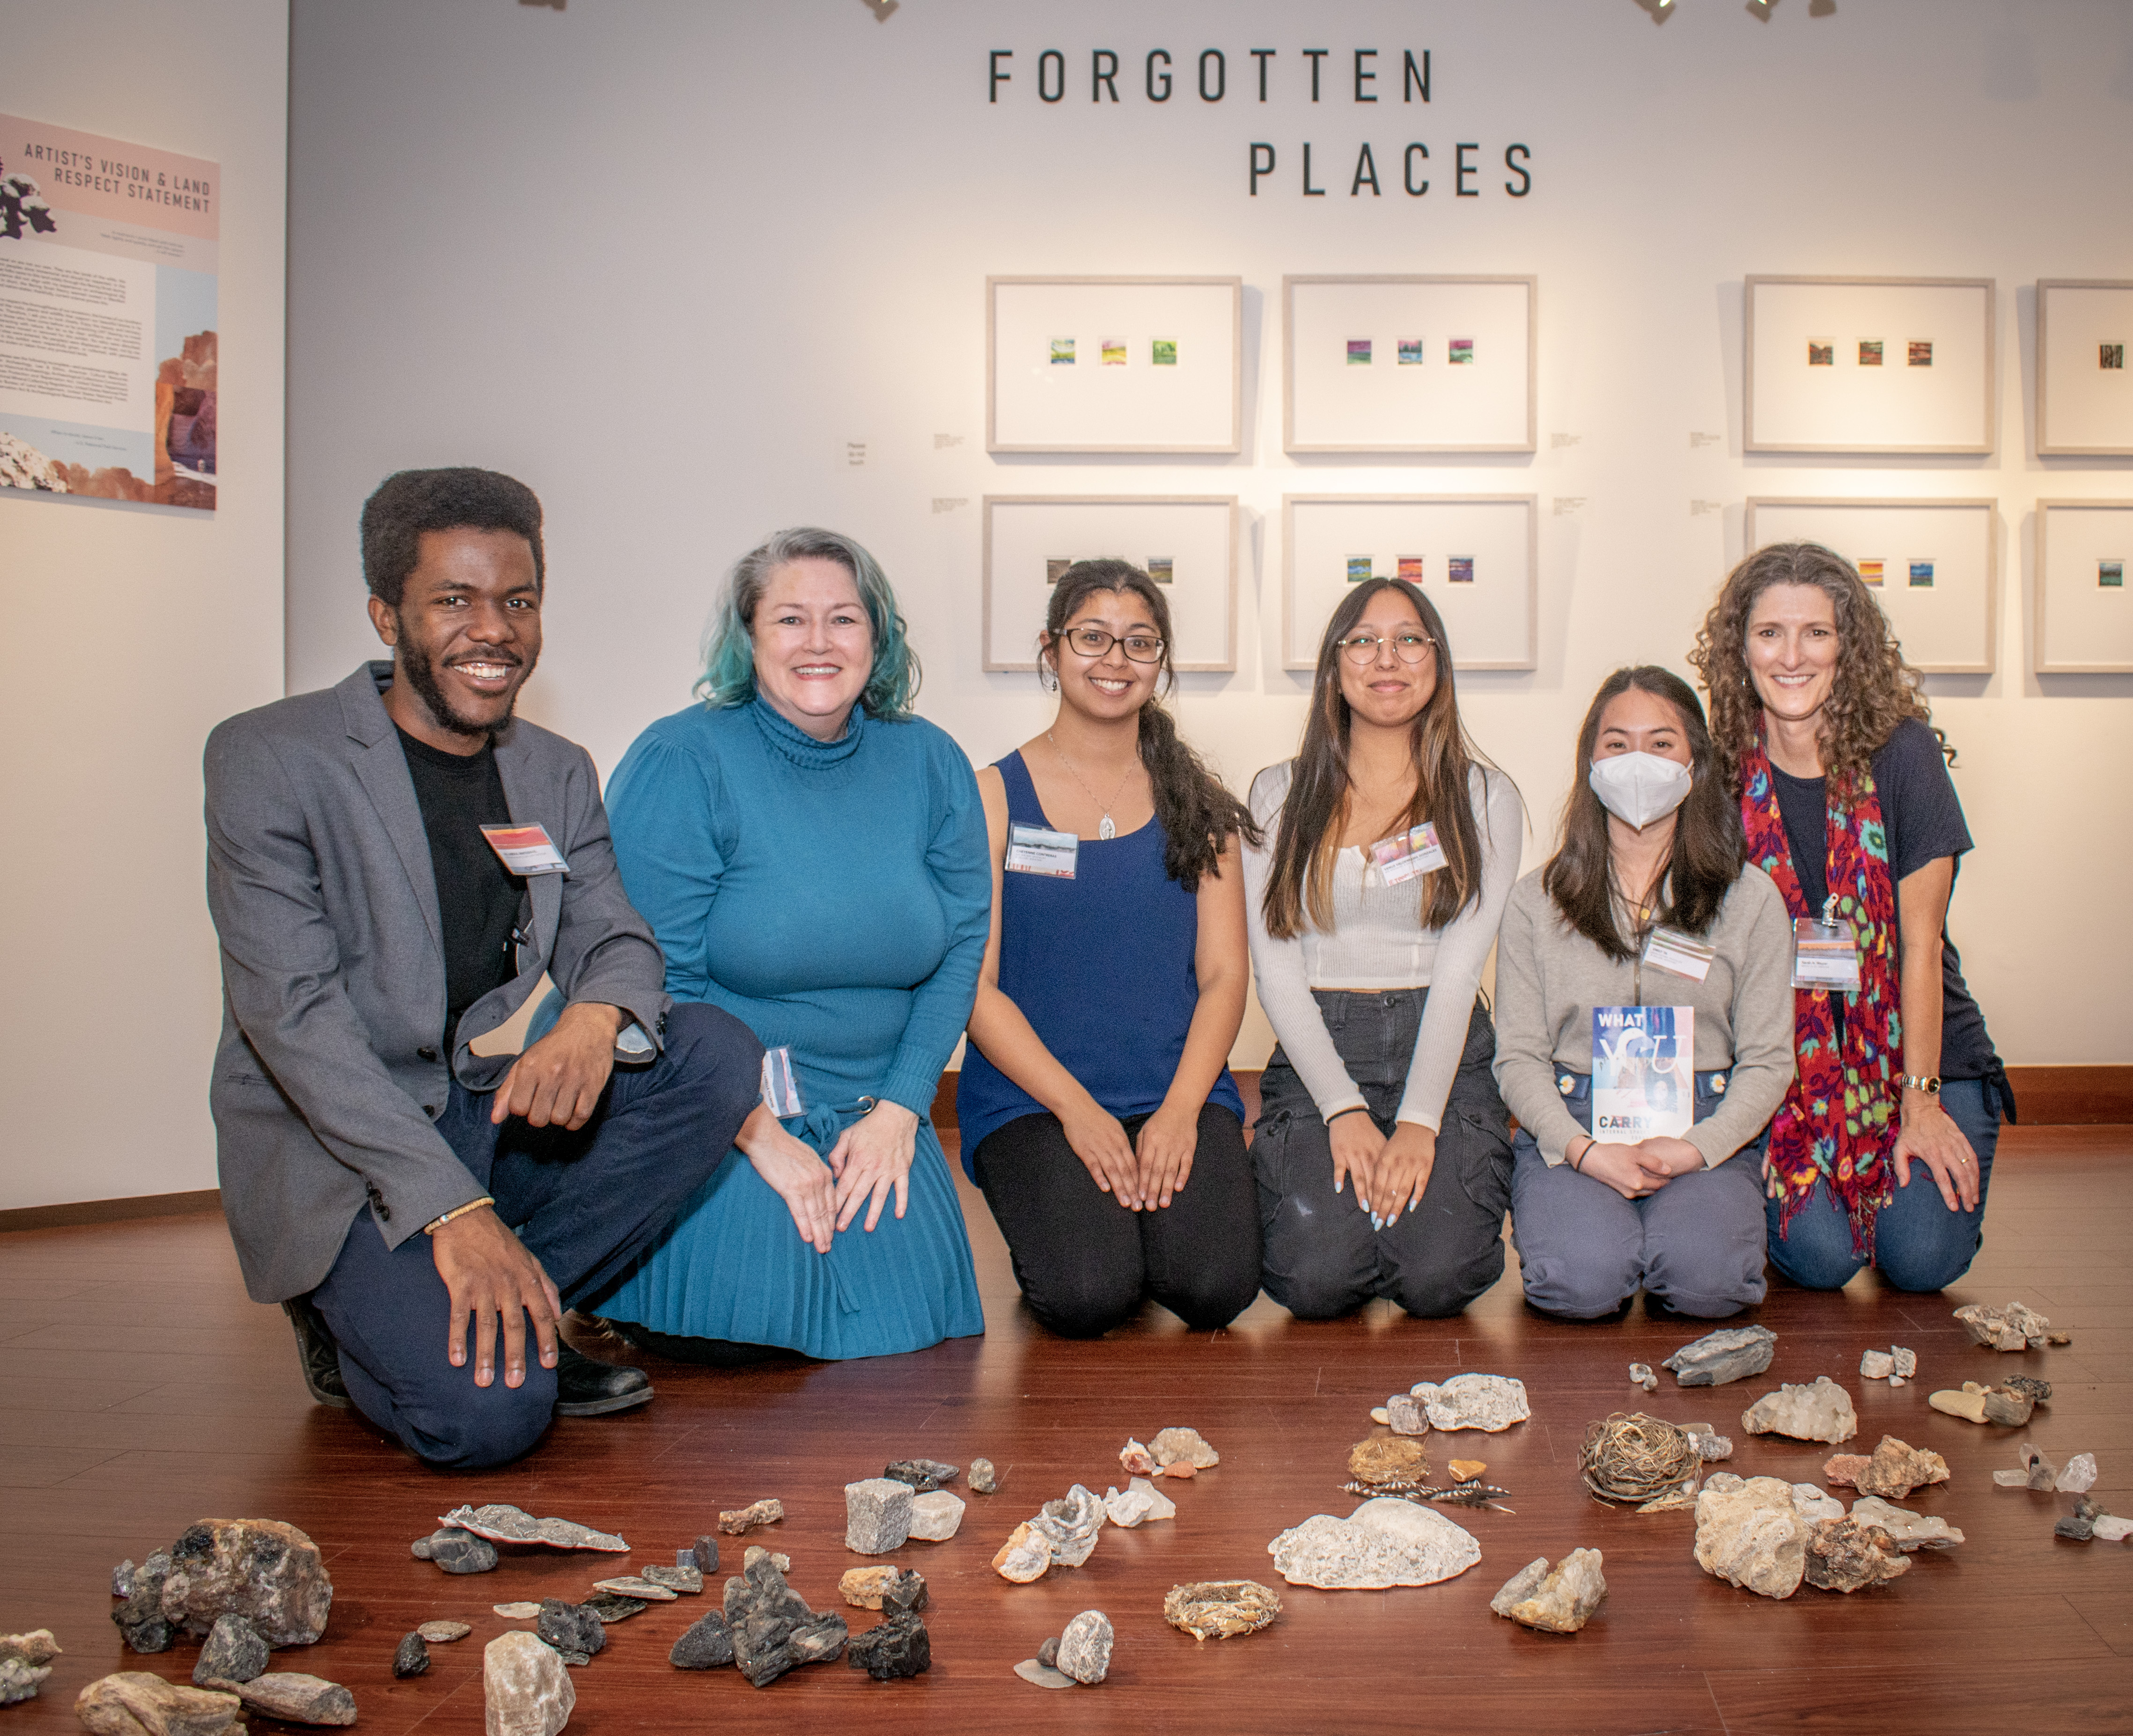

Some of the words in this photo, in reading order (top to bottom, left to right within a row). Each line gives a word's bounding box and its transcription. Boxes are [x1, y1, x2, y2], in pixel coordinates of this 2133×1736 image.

[989, 49, 1431, 103] FORGOTTEN
[24, 143, 92, 170] ARTIST'S
[101, 159, 149, 183] VISION
[157, 172, 166, 186] &
[174, 176, 210, 196] LAND
[54, 168, 120, 194] RESPECT
[128, 184, 210, 213] STATEMENT
[1249, 142, 1531, 198] PLACES
[1598, 1013, 1644, 1027] WHAT
[1599, 1115, 1652, 1128] CARRY
